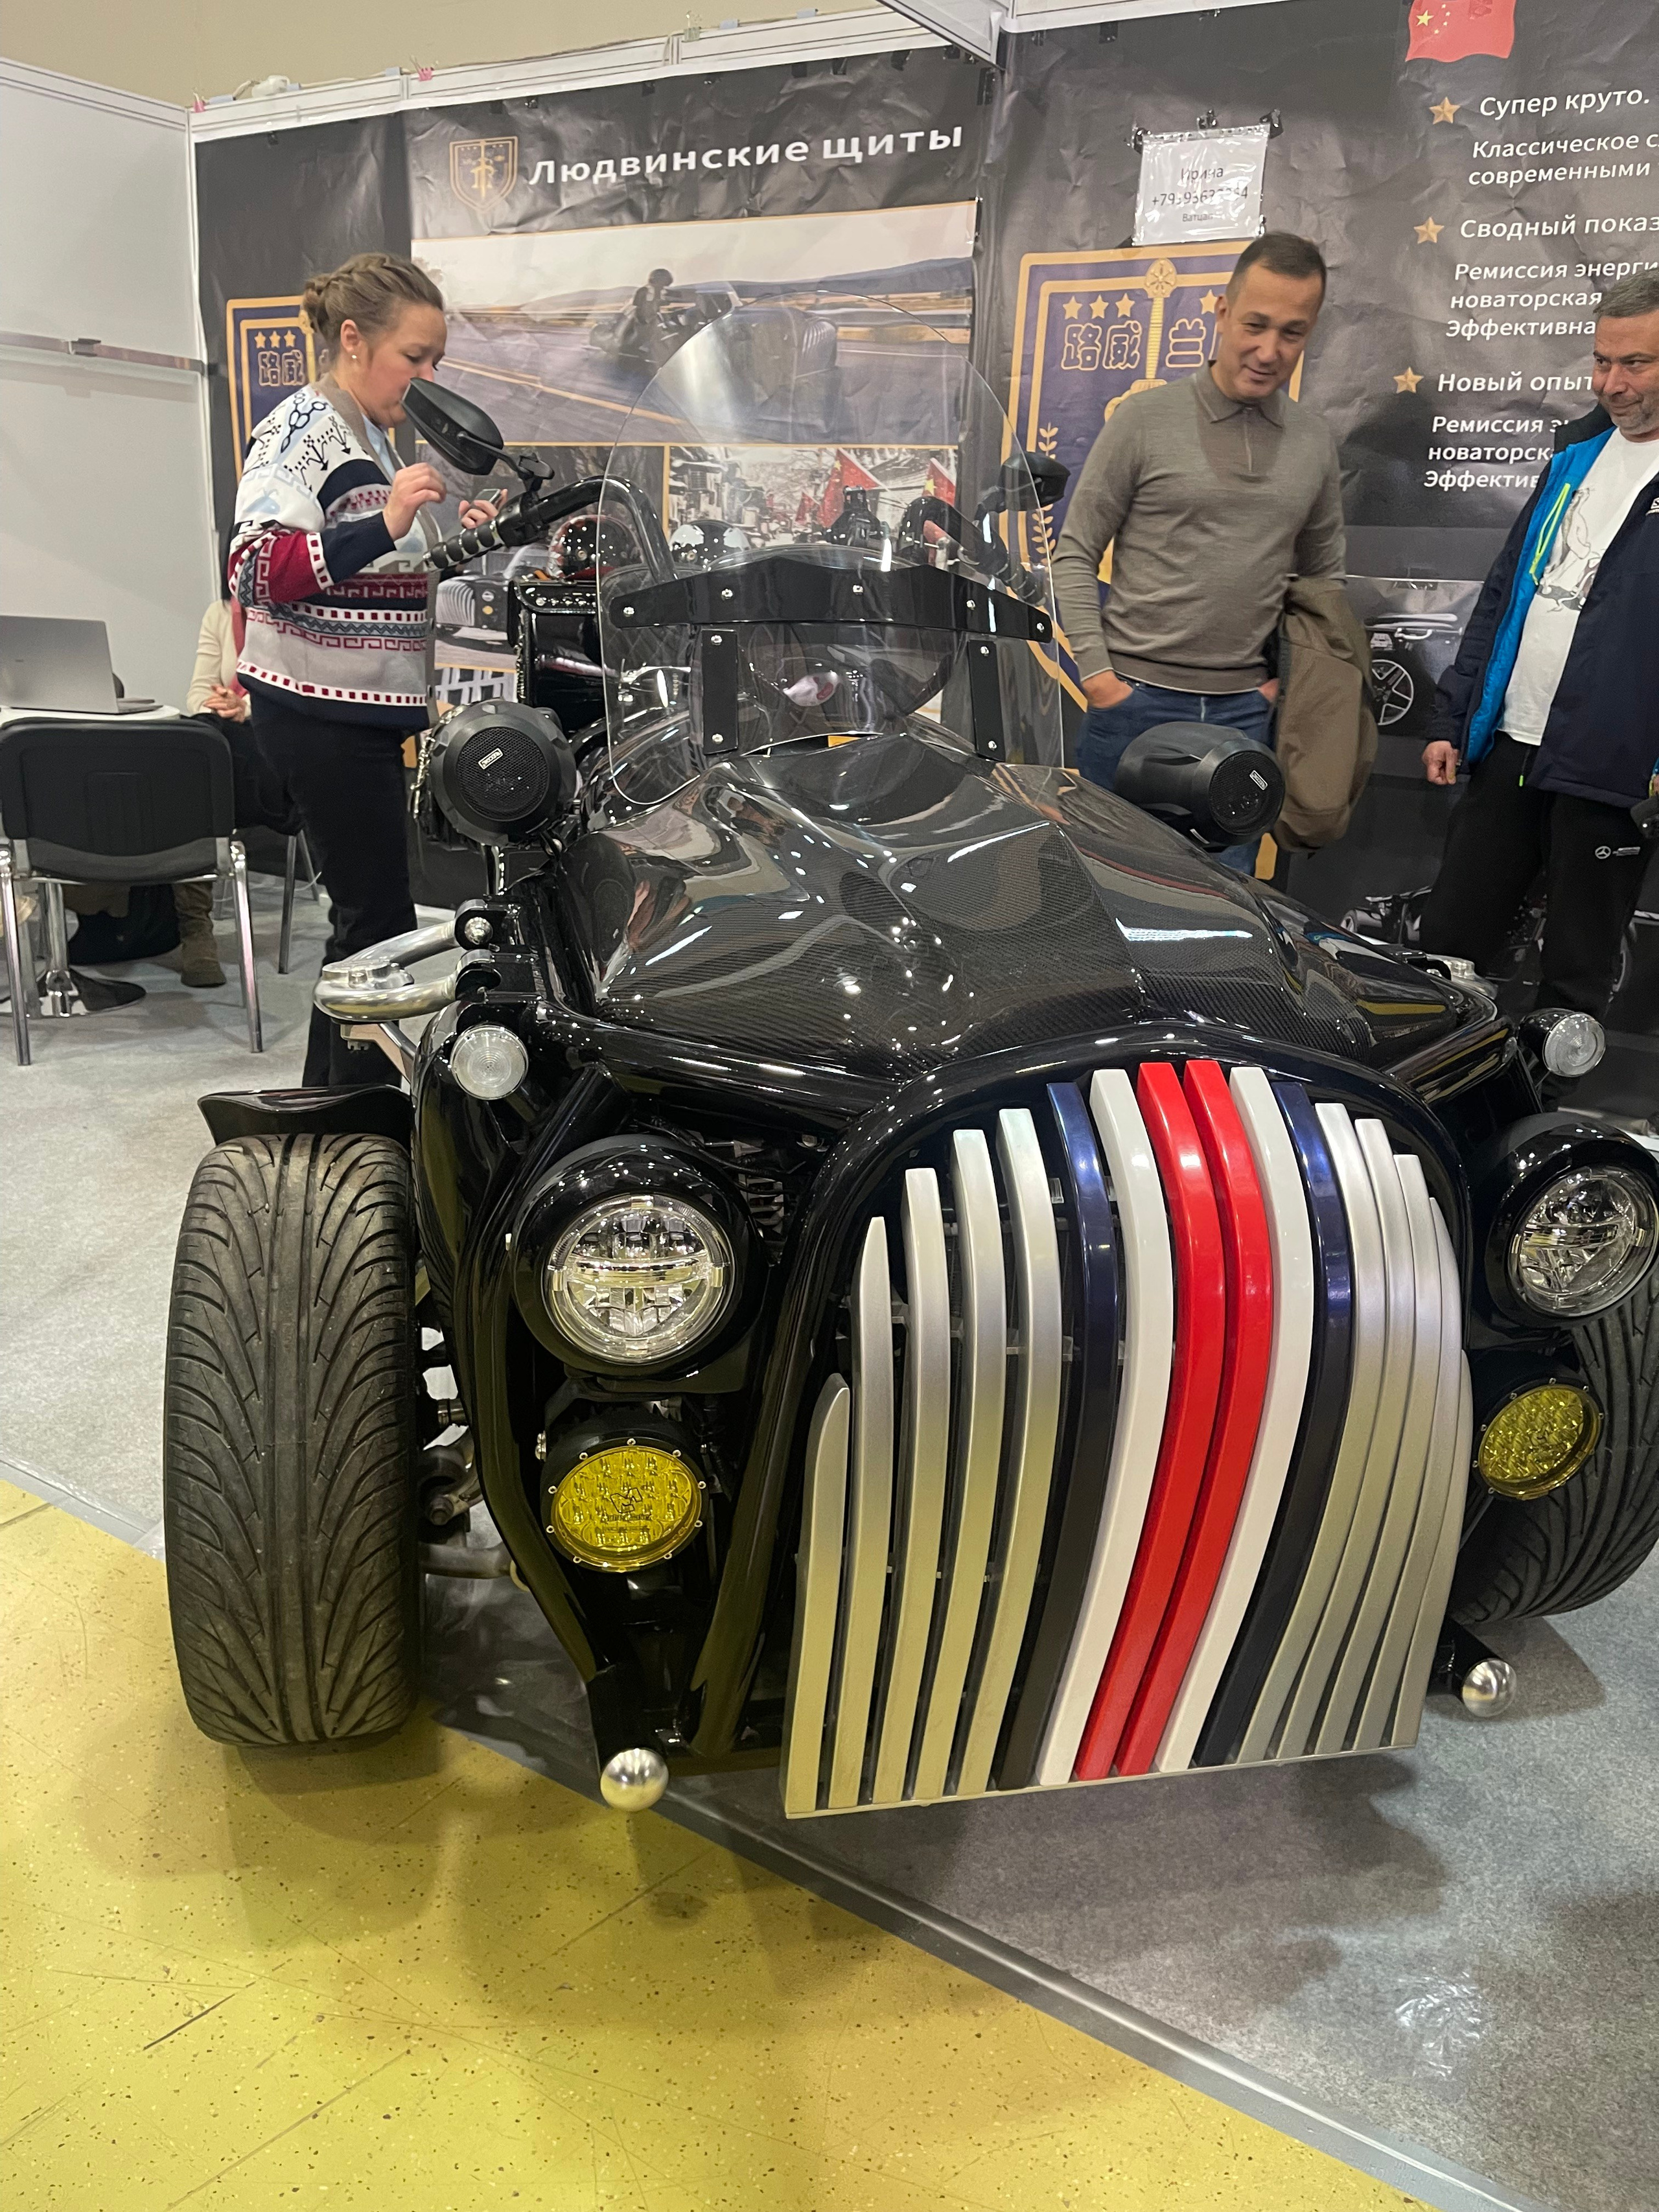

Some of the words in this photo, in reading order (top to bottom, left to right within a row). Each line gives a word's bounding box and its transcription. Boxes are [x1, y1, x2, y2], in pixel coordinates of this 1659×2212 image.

[1480, 97, 1557, 121] Супер
[1565, 89, 1650, 114] круто.
[529, 141, 809, 185] Людвинские
[822, 126, 962, 163] щиты
[1472, 134, 1640, 158] Классическое
[1468, 163, 1651, 188] современными
[1460, 214, 1577, 240] Сводный
[1455, 263, 1568, 280] Ремиссия
[1450, 292, 1603, 310] новаторская
[1446, 318, 1597, 341] Эффективна
[1437, 371, 1522, 392] Новый
[1432, 416, 1544, 433] Ремиссия
[1428, 447, 1554, 465] новаторск
